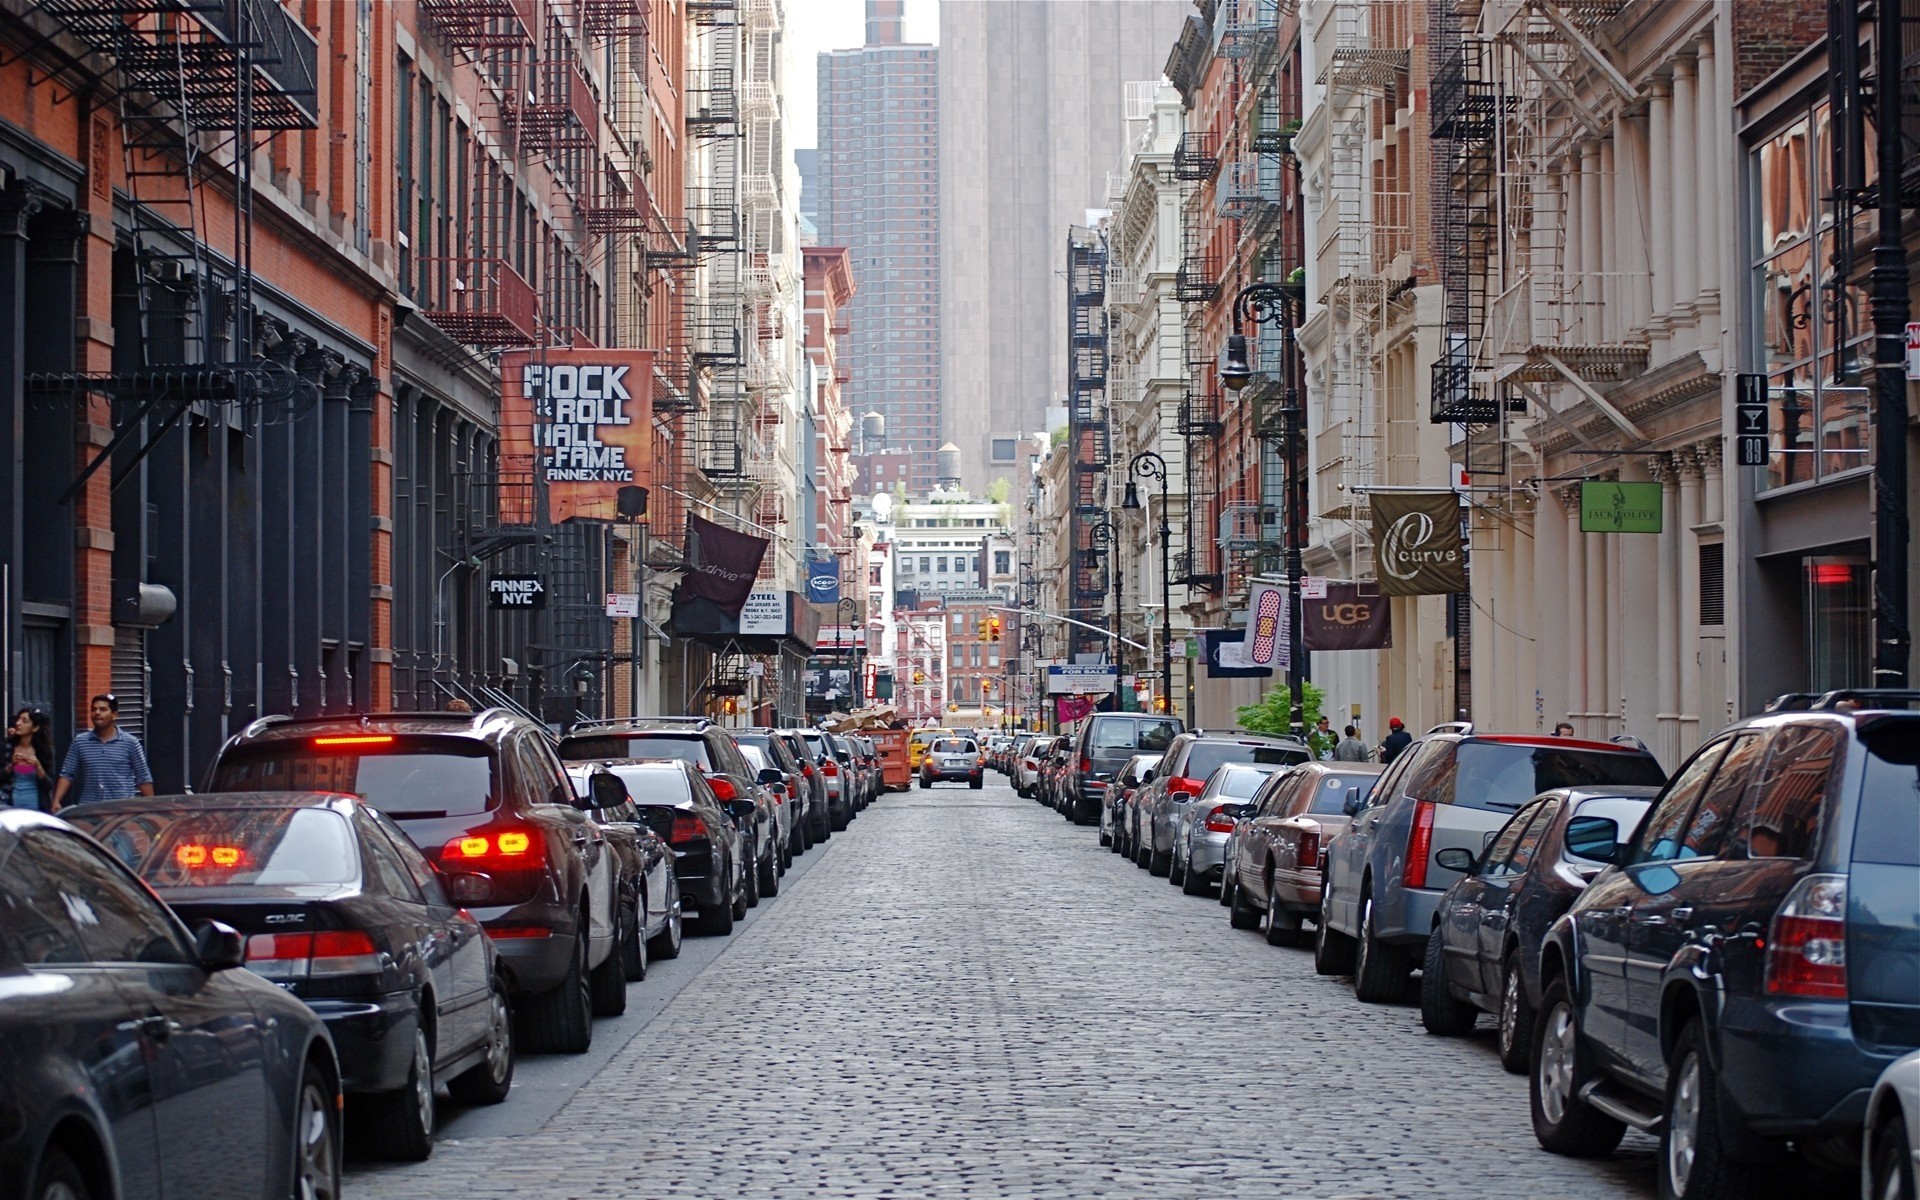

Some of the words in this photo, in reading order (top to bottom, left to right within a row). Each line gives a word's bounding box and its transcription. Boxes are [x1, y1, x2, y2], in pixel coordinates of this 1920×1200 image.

[1908, 327, 1920, 345] N
[523, 365, 631, 399] ROCK
[556, 399, 630, 424] ROLL
[533, 423, 603, 447] HALL
[555, 446, 625, 468] FAME
[1745, 438, 1761, 463] 89
[546, 468, 599, 480] ANNEX
[603, 470, 633, 481] NYC
[1588, 510, 1613, 519] JACK
[1623, 510, 1656, 519] OLIVE
[1398, 549, 1456, 562] curve
[706, 564, 738, 582] drive
[490, 580, 543, 592] ANNEX
[502, 592, 532, 605] NYC
[1322, 603, 1371, 625] UGG
